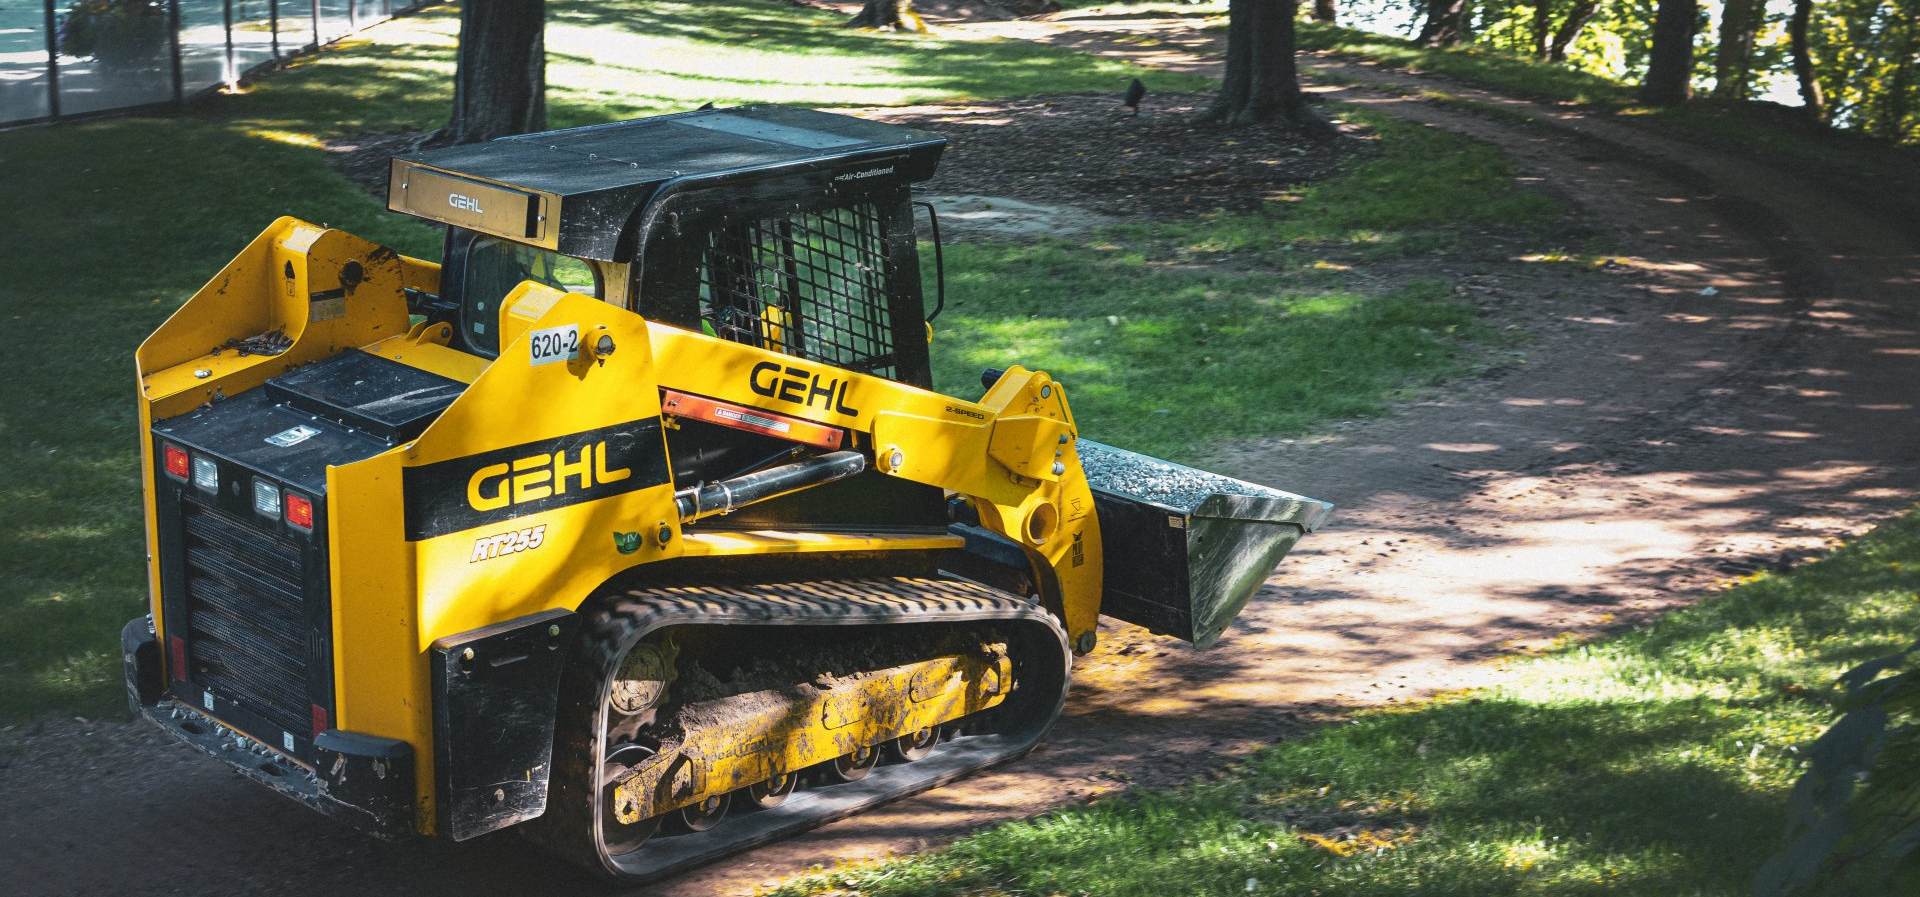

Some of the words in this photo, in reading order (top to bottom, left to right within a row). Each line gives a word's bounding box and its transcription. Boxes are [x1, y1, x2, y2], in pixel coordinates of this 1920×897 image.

[844, 165, 894, 181] Air-Conditioned
[448, 193, 484, 214] GEHL
[531, 329, 578, 359] 620-2
[749, 360, 859, 417] GEHL
[945, 405, 985, 420] 2-SPEED
[467, 441, 631, 512] GEHL
[469, 523, 548, 564] RT255
